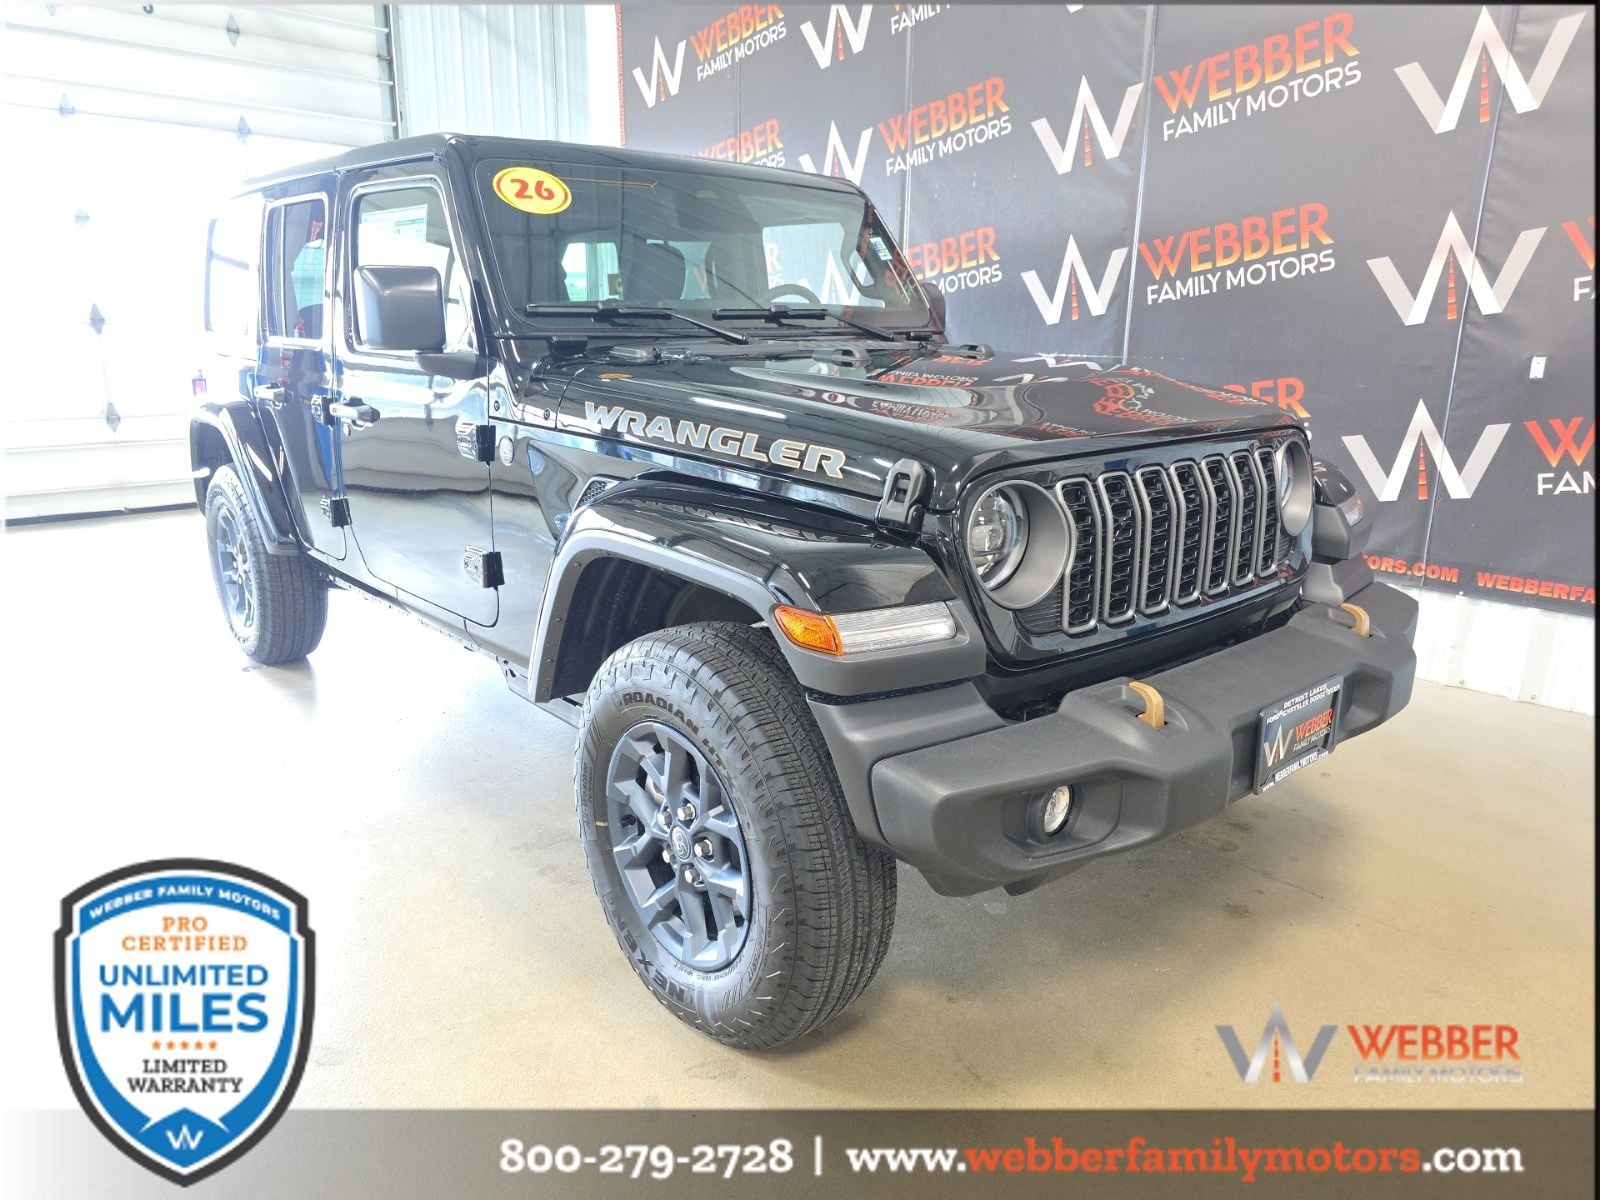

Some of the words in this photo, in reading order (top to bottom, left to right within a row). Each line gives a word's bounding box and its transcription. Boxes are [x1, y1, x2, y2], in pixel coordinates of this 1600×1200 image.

[696, 50, 732, 81] FAMILY
[735, 21, 787, 62] MOTORS
[1154, 12, 1360, 114] WEBBER
[878, 76, 1010, 154] WEBBER
[1163, 98, 1241, 141] FAMILY
[1246, 60, 1361, 117] MOTORS
[886, 142, 936, 176] FAMILY
[939, 116, 1012, 157] MOTORS
[510, 178, 555, 200] 26
[905, 226, 1000, 280] EBBER
[1138, 202, 1334, 280] WEBBER
[1146, 271, 1218, 305] FAMILY
[1226, 248, 1336, 287] MOTORS
[584, 401, 846, 480] WRANGLER
[1363, 555, 1459, 582] ORS.COM
[622, 691, 699, 735] ROADIAN
[1296, 708, 1333, 741] WEBBER
